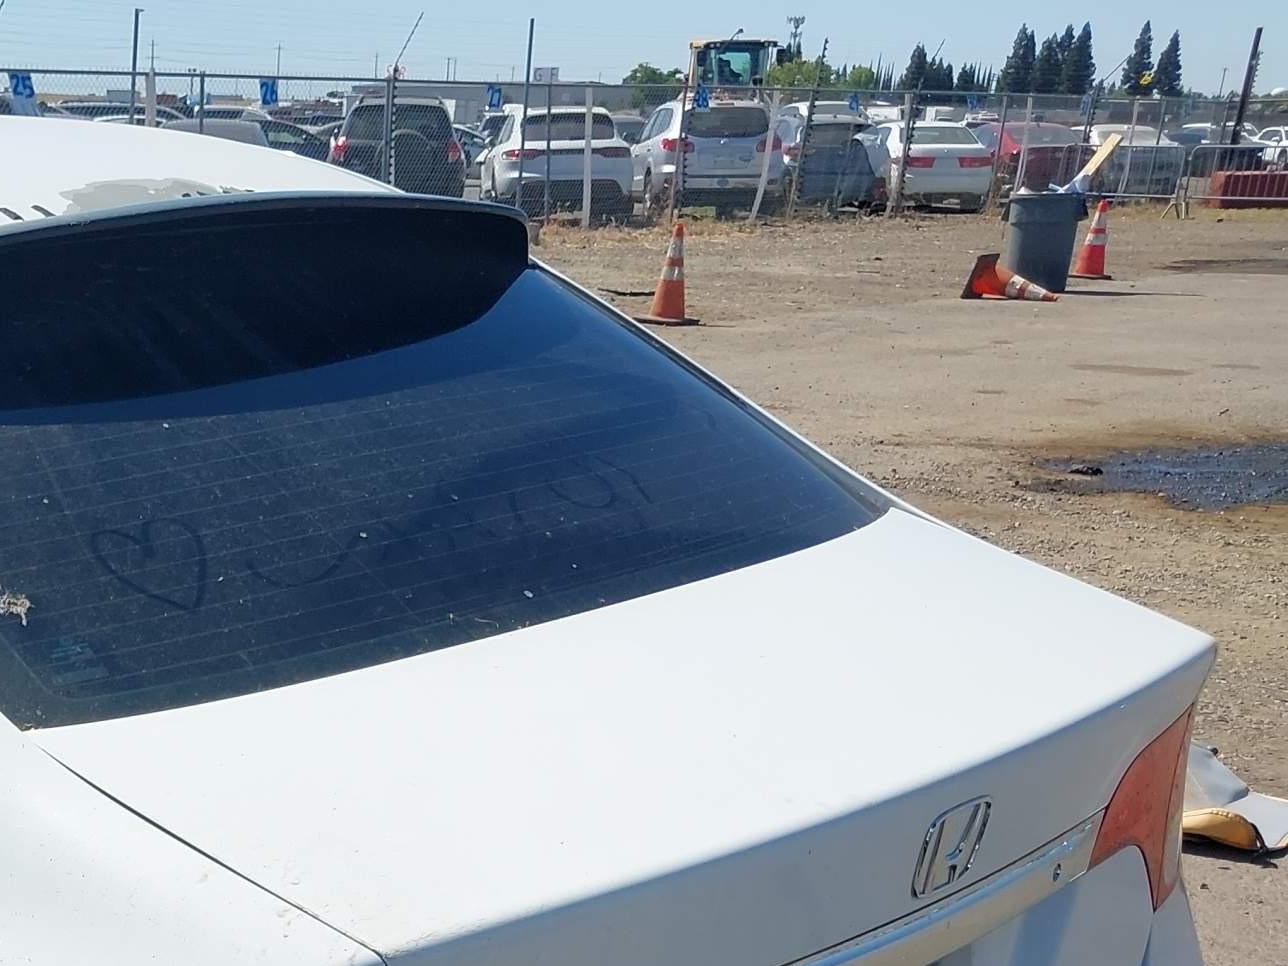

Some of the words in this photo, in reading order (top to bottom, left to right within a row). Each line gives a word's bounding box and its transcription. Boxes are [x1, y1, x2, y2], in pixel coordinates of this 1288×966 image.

[10, 73, 35, 99] 25
[260, 80, 278, 105] 26
[487, 86, 502, 109] 27
